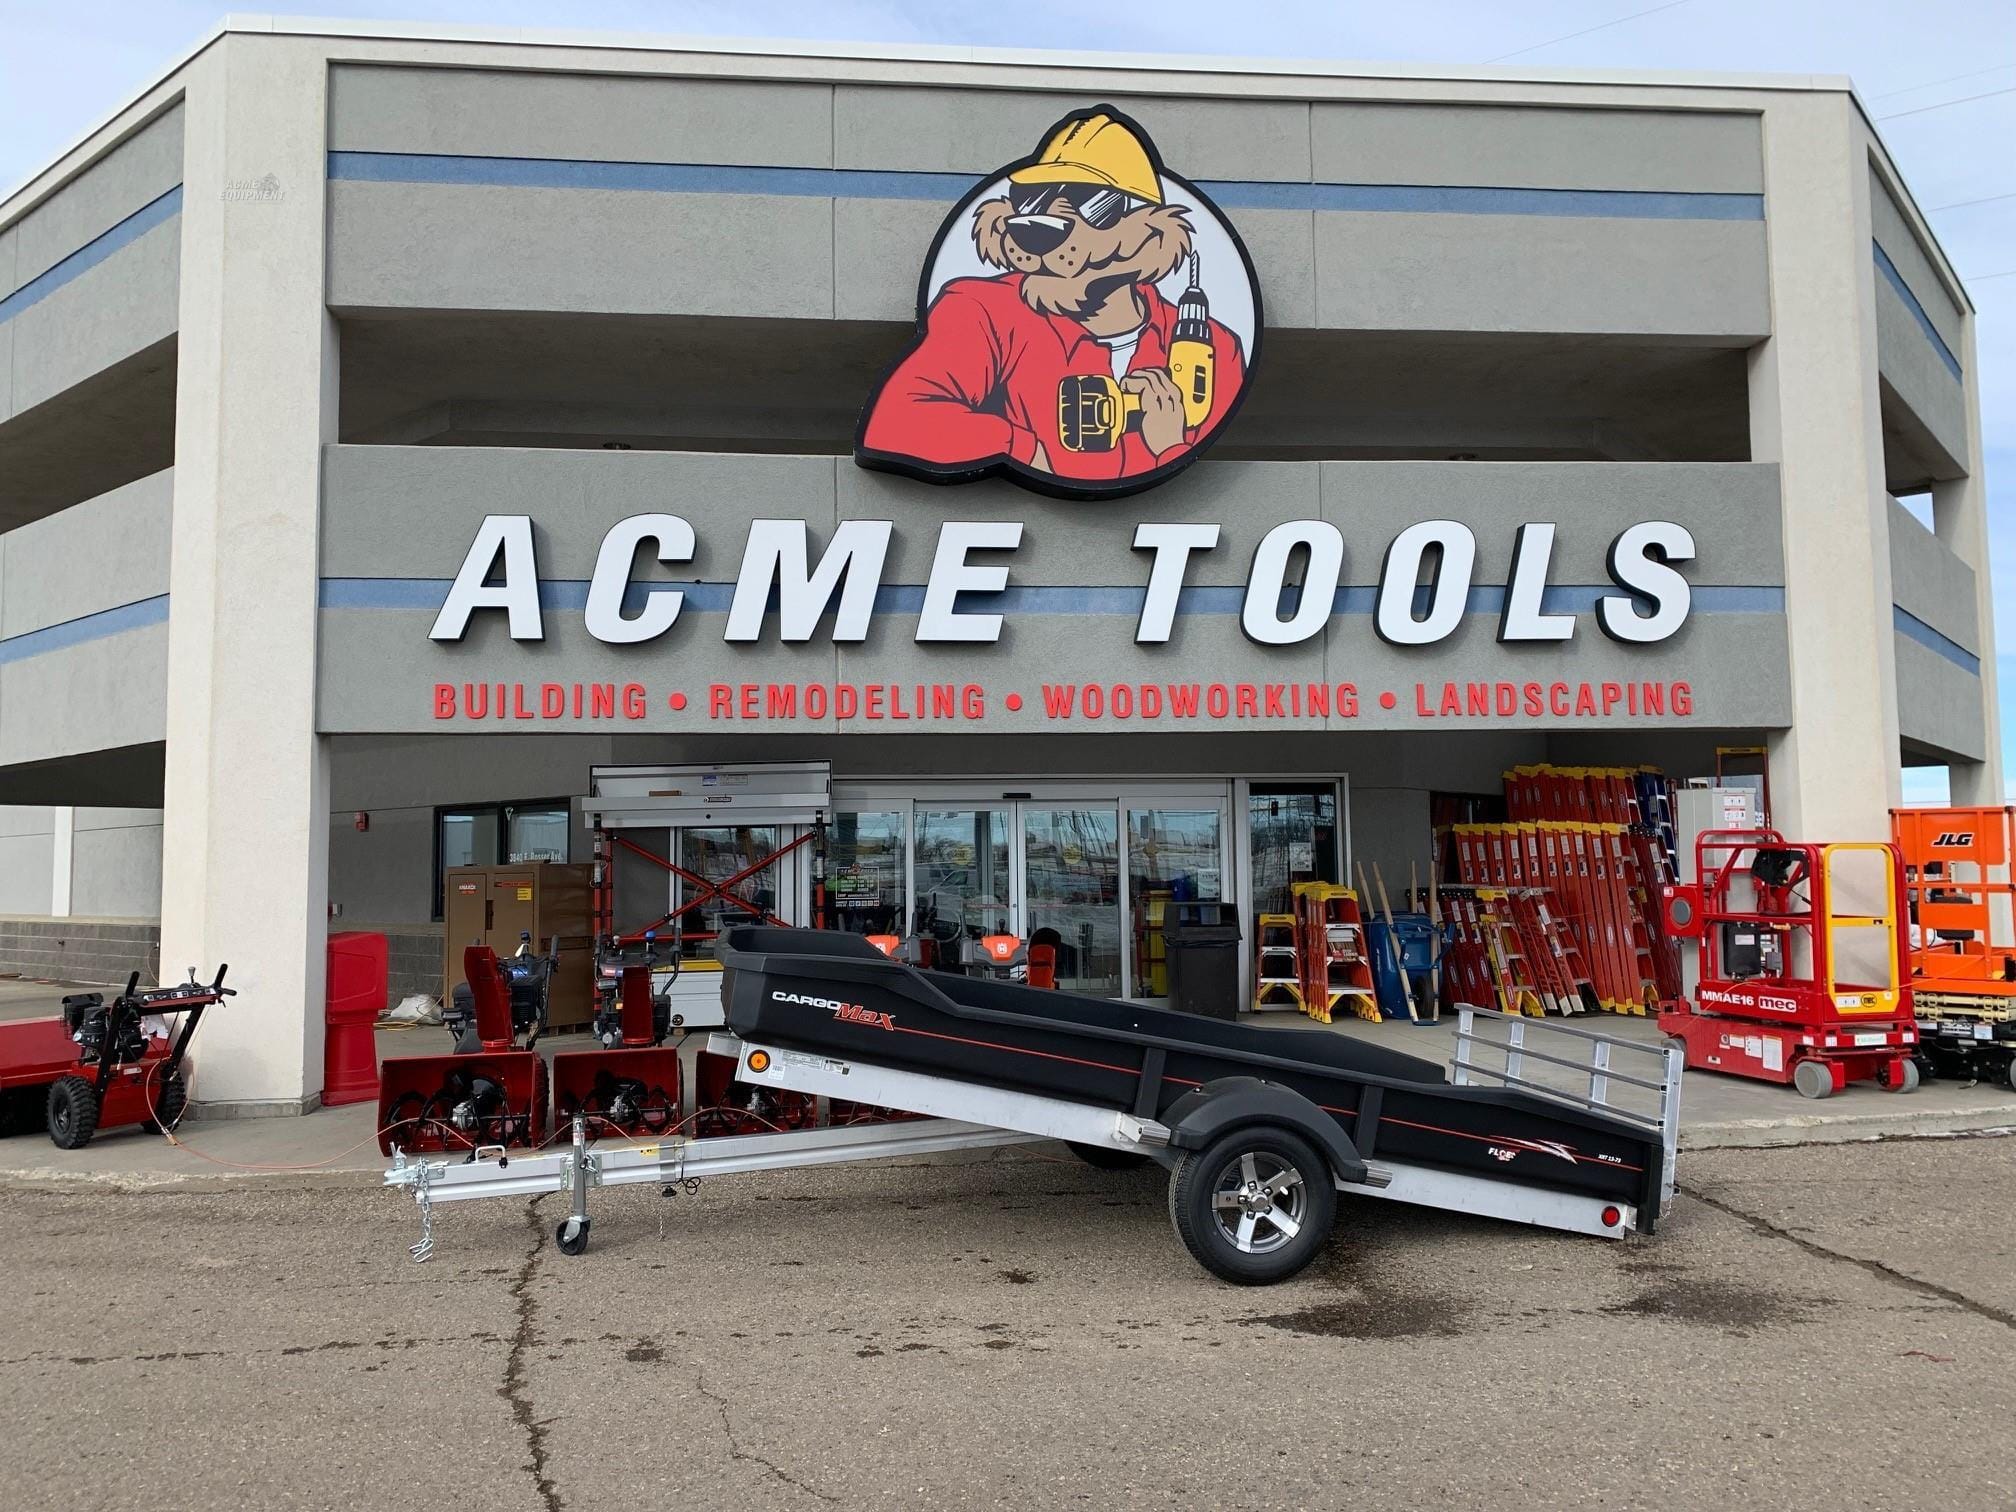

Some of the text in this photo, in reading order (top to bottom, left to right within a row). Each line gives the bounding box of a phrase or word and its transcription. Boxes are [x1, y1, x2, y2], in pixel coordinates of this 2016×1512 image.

[427, 513, 1697, 644] ACME TOOLS
[433, 682, 1692, 720] BUILDING REMODELING WOODWORKING LANDSCAPING
[1932, 833, 1974, 846] JLG
[1701, 990, 1796, 1012] MMAE16 mec
